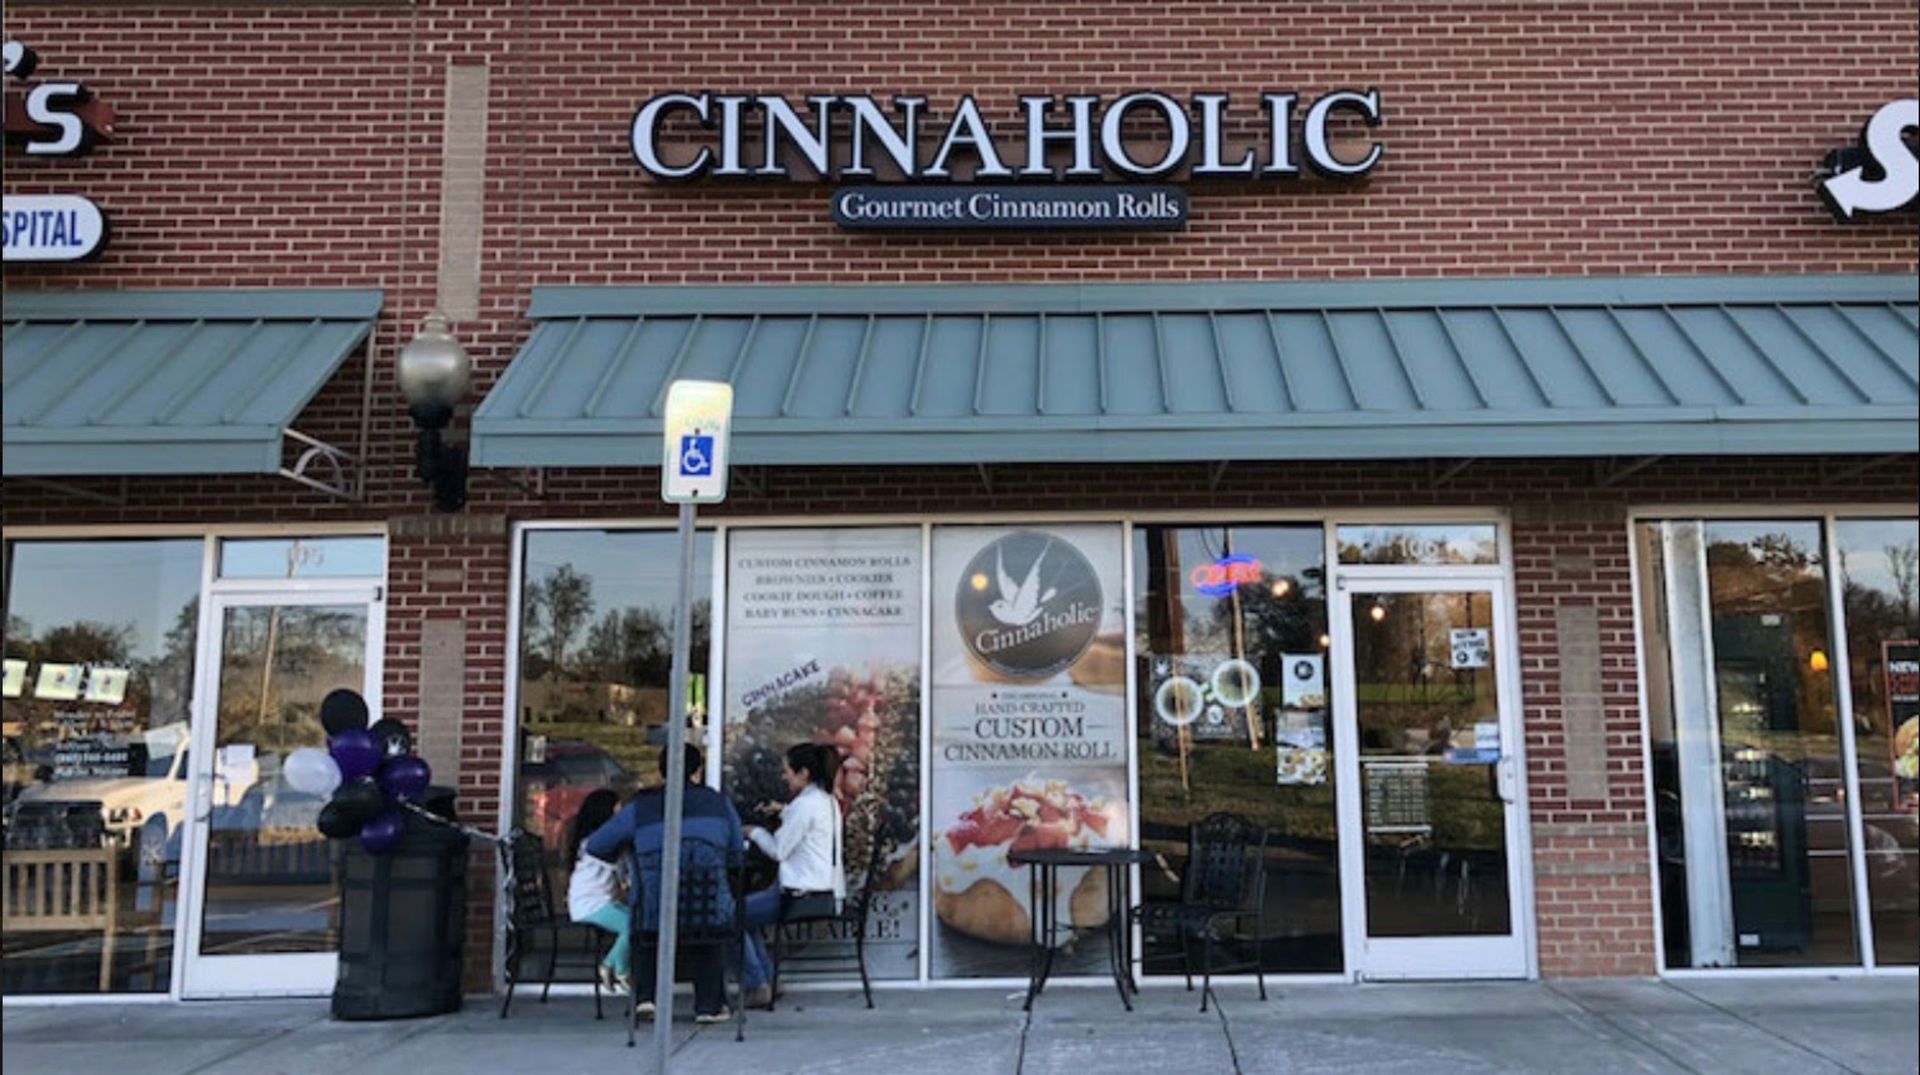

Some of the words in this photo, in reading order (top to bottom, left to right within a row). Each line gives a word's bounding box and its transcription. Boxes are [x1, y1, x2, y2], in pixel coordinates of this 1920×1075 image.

[630, 91, 1383, 177] CINNAHOLIC
[840, 193, 962, 219] Gourmet
[968, 193, 1111, 219] Cinnamon
[1116, 192, 1180, 218] Rolls
[738, 557, 792, 569] CUSTOM
[794, 556, 866, 568] CINNAMON
[869, 556, 911, 567] ROLLS
[755, 574, 826, 585] BROWNIES
[836, 573, 893, 584] COOKIES
[743, 591, 792, 602] COOKIE
[796, 590, 844, 601] DOUGH
[855, 589, 902, 600] COFFEE
[827, 606, 902, 617] CINNACAKE
[975, 601, 1096, 654] Cinnaholic
[742, 659, 820, 707] CINNACAKE
[975, 717, 1083, 739] CUSTOM
[944, 741, 1060, 762] CINNAMON
